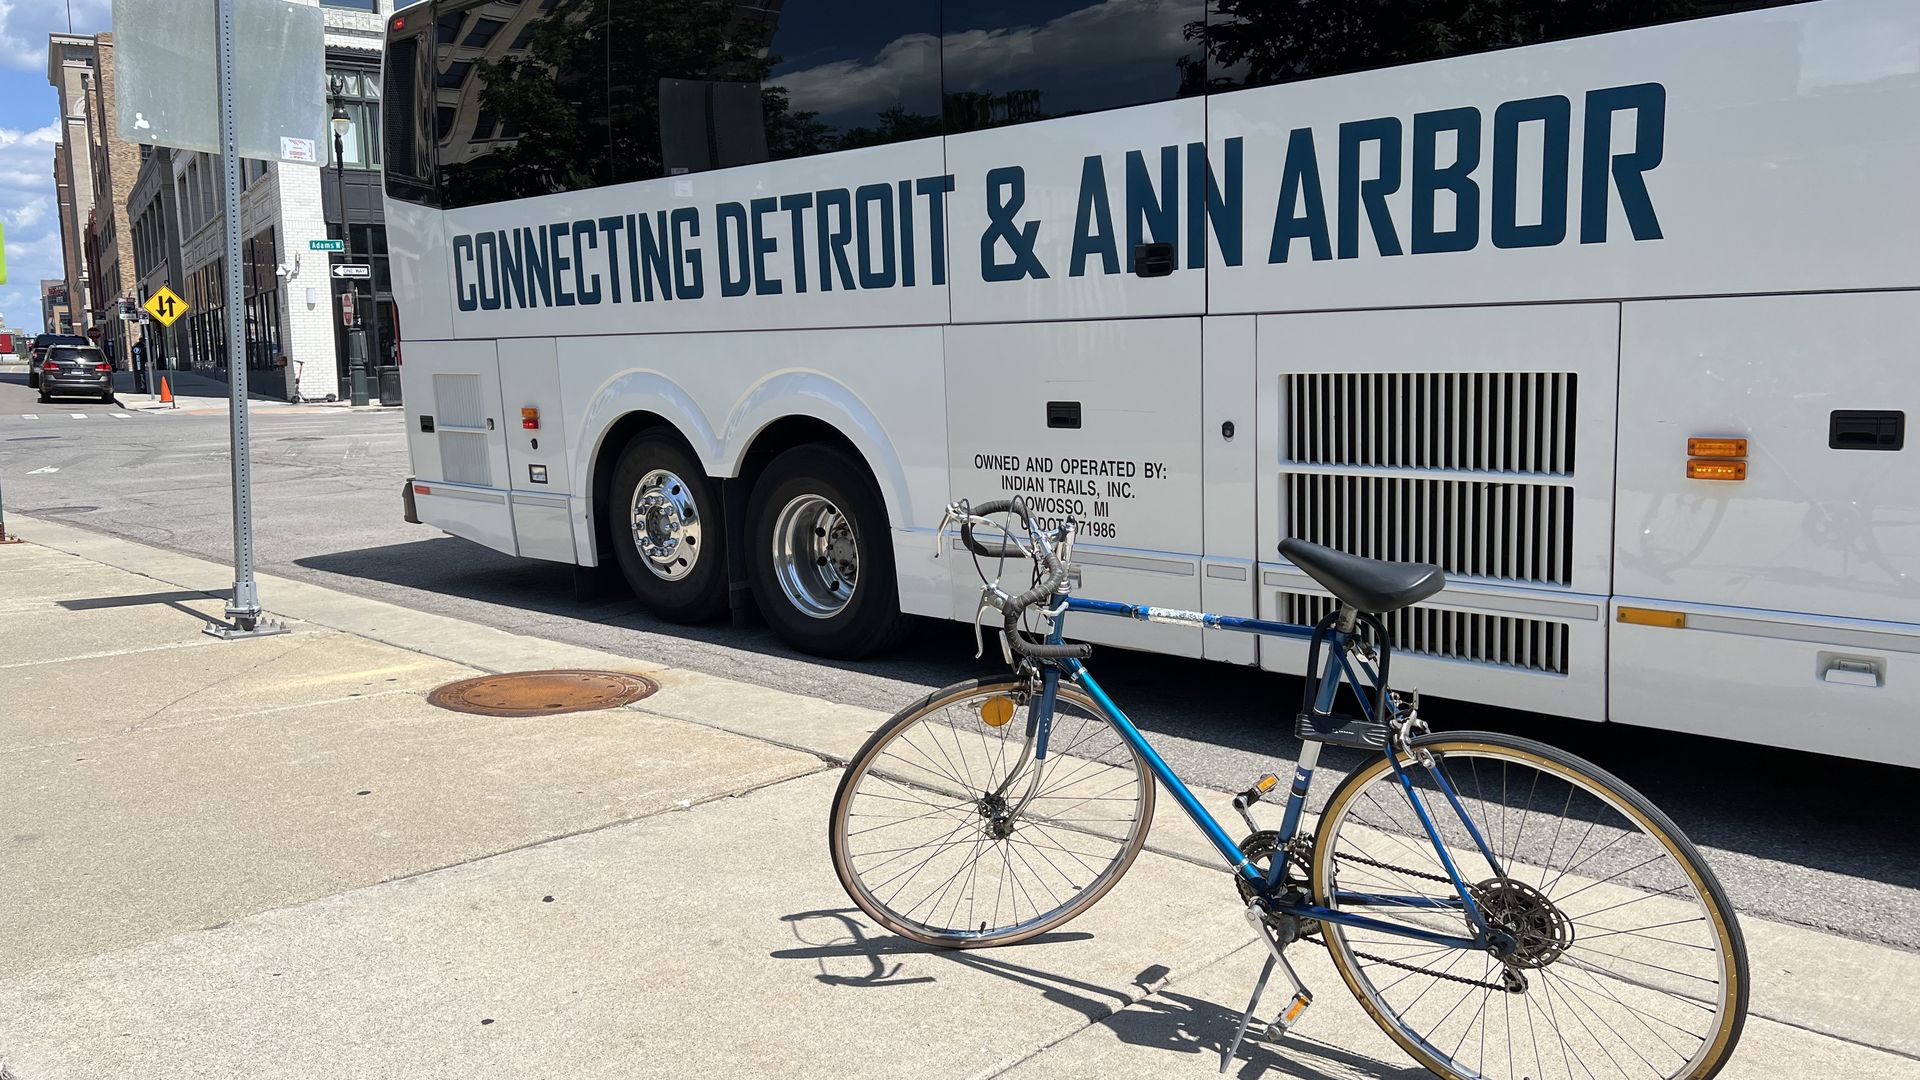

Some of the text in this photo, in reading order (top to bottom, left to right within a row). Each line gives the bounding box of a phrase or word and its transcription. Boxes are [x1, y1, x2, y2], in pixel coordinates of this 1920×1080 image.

[453, 82, 1667, 312] CONNECTING DETROIT & ANN ARBOR
[311, 241, 341, 249] Adams W
[974, 453, 1167, 479] OWNED AND OPERATED BY:
[1001, 475, 1136, 499] INDIAN TRAILS, INC.
[1025, 496, 1109, 518] OWOSSO, MI
[1020, 515, 1064, 531] UDOT
